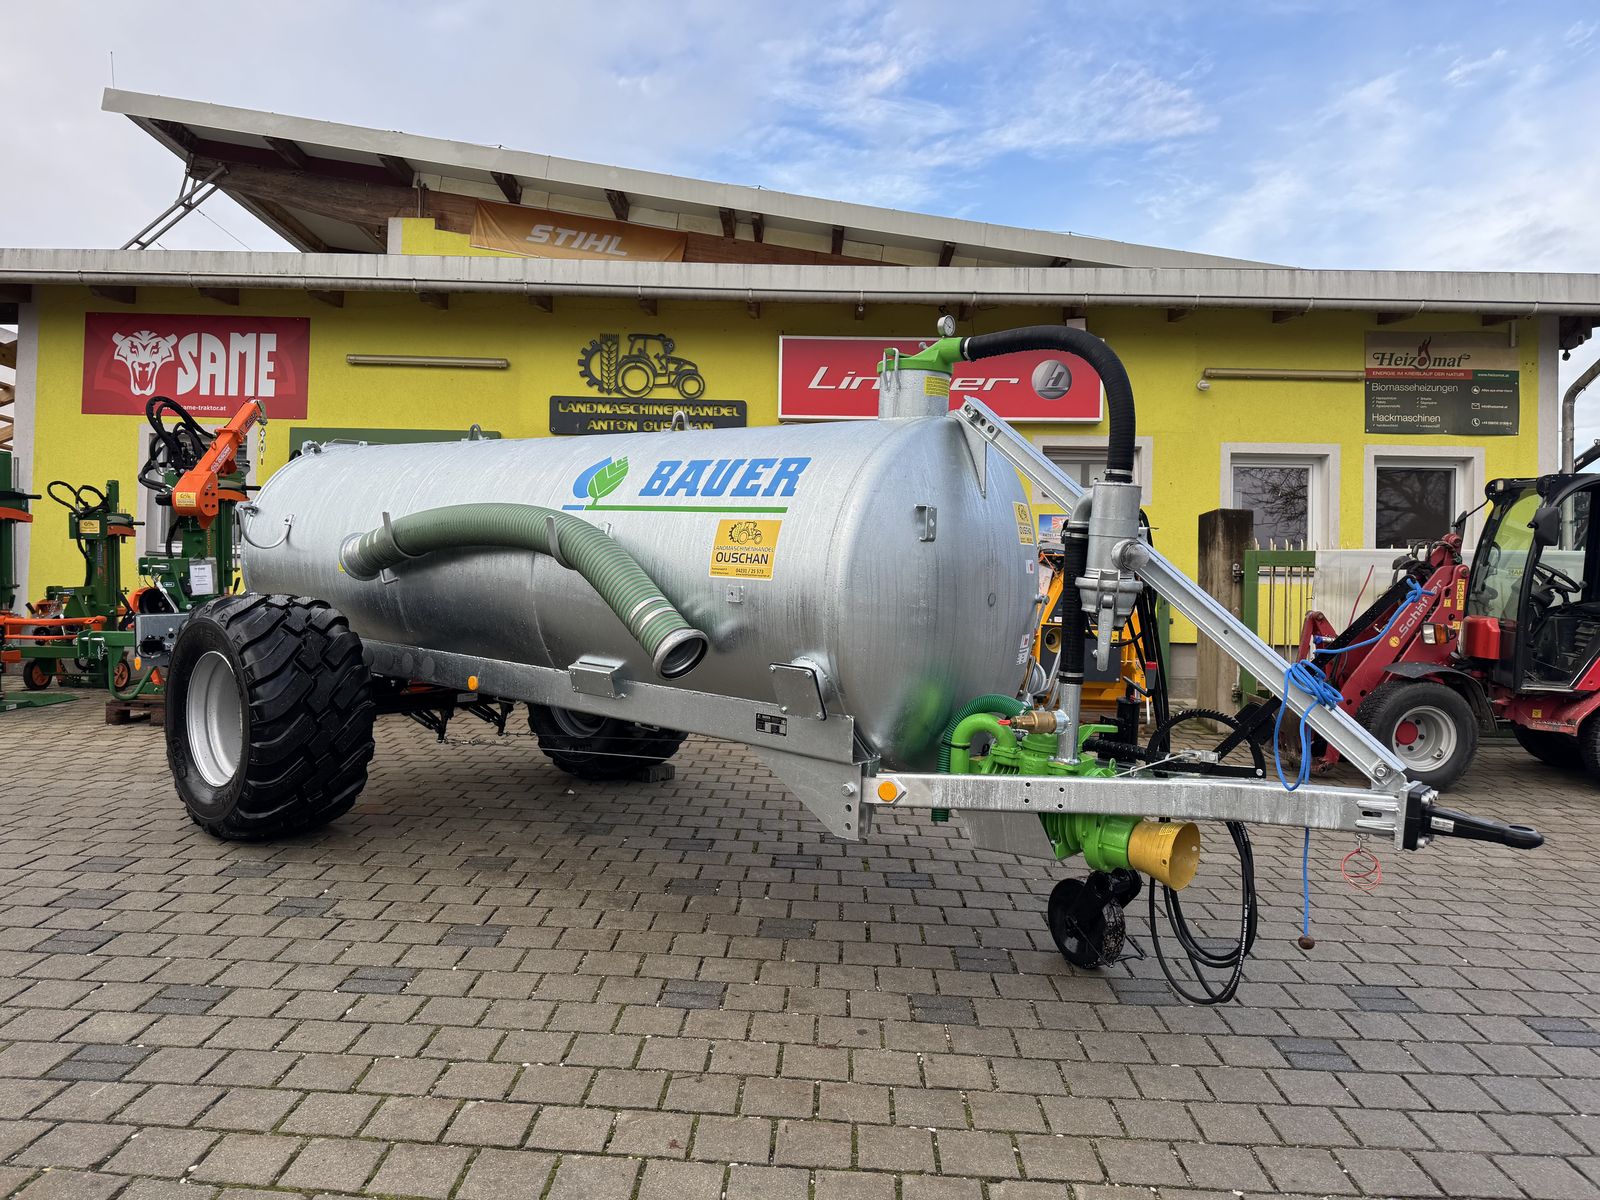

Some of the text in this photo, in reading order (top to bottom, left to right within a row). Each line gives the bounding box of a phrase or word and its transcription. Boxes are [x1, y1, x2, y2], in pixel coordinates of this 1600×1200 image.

[526, 224, 628, 256] STIHL
[176, 332, 277, 397] SAME
[808, 366, 1019, 391] Liner
[1371, 382, 1459, 394] Biomasseheizungen
[558, 400, 741, 417] LANDMASCHINENHANDEL
[1371, 413, 1441, 423] Hackmaschinen
[587, 419, 638, 432] ANTON
[638, 457, 812, 497] BAUER
[715, 552, 769, 564] OUSCHAN
[1399, 580, 1442, 639] Schäfer
